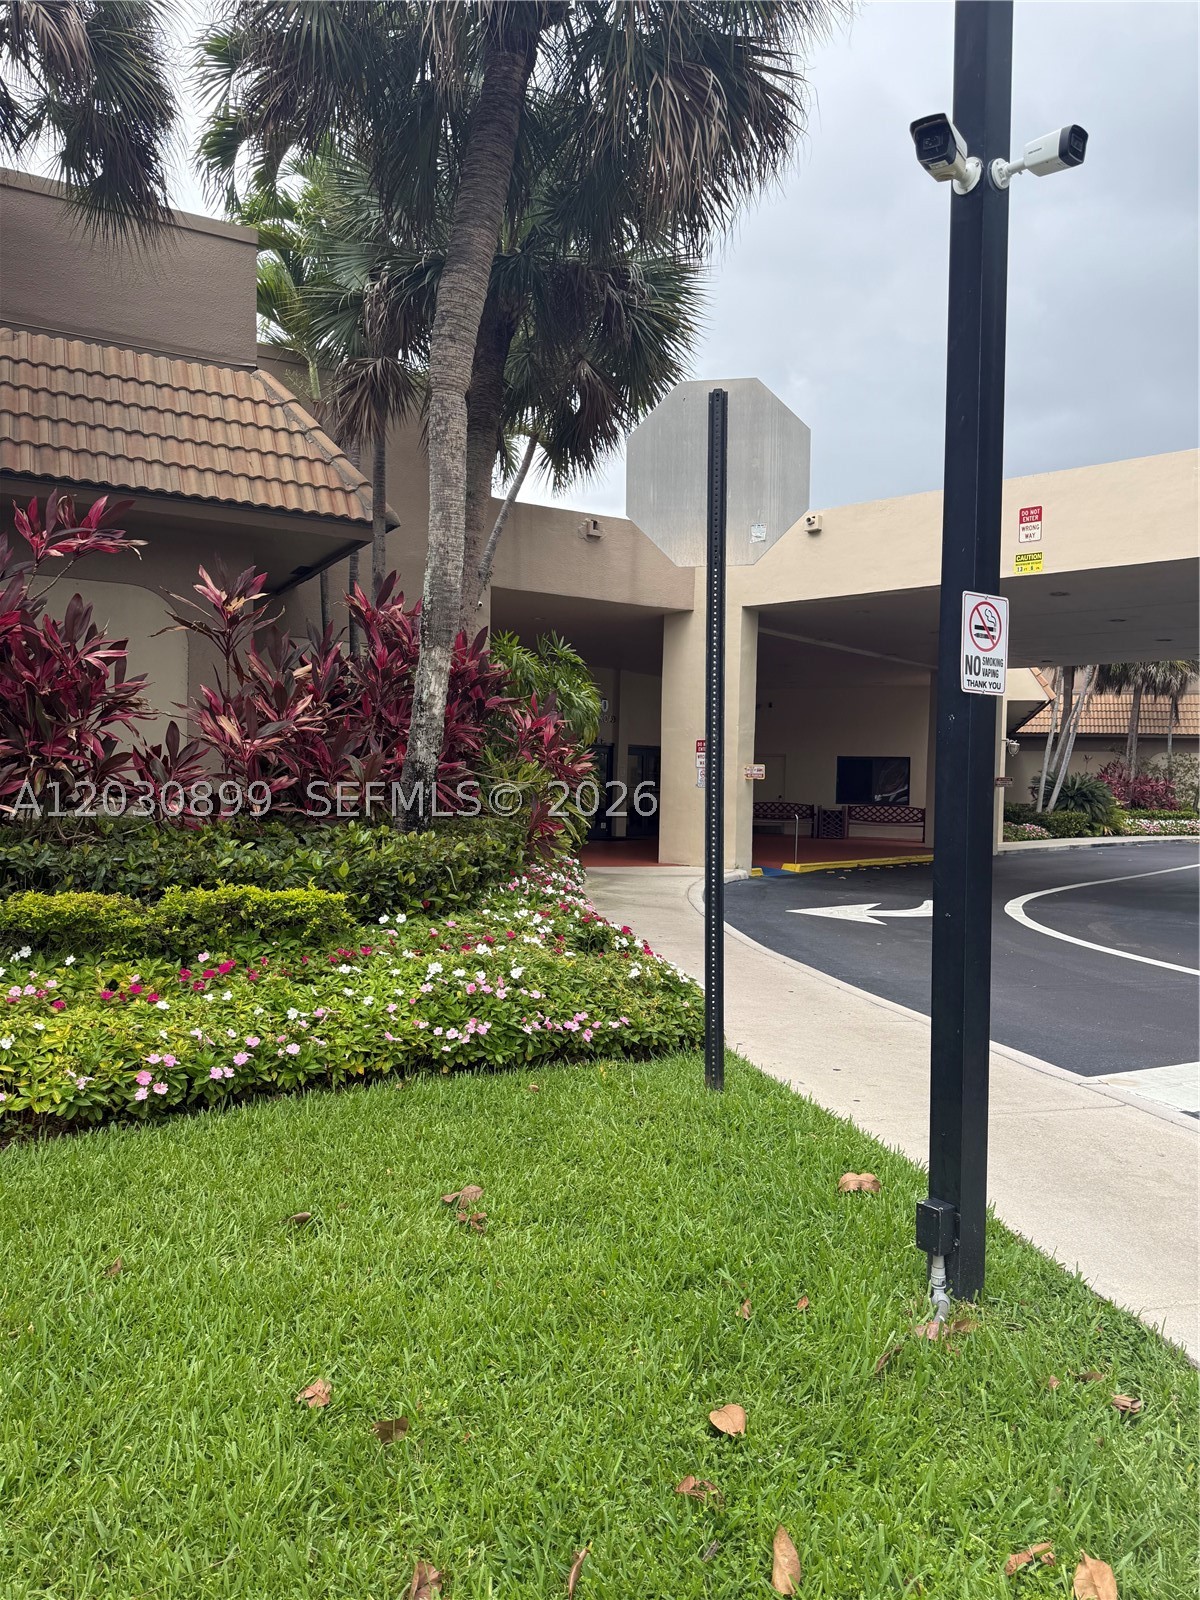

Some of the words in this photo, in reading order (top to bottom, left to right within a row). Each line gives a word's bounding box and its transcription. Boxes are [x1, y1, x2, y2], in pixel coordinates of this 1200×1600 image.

[965, 654, 981, 676] NO
[982, 656, 1003, 667] SMOKING
[982, 667, 999, 678] VAPING
[967, 679, 987, 689] THANK
[988, 681, 1002, 690] YOU
